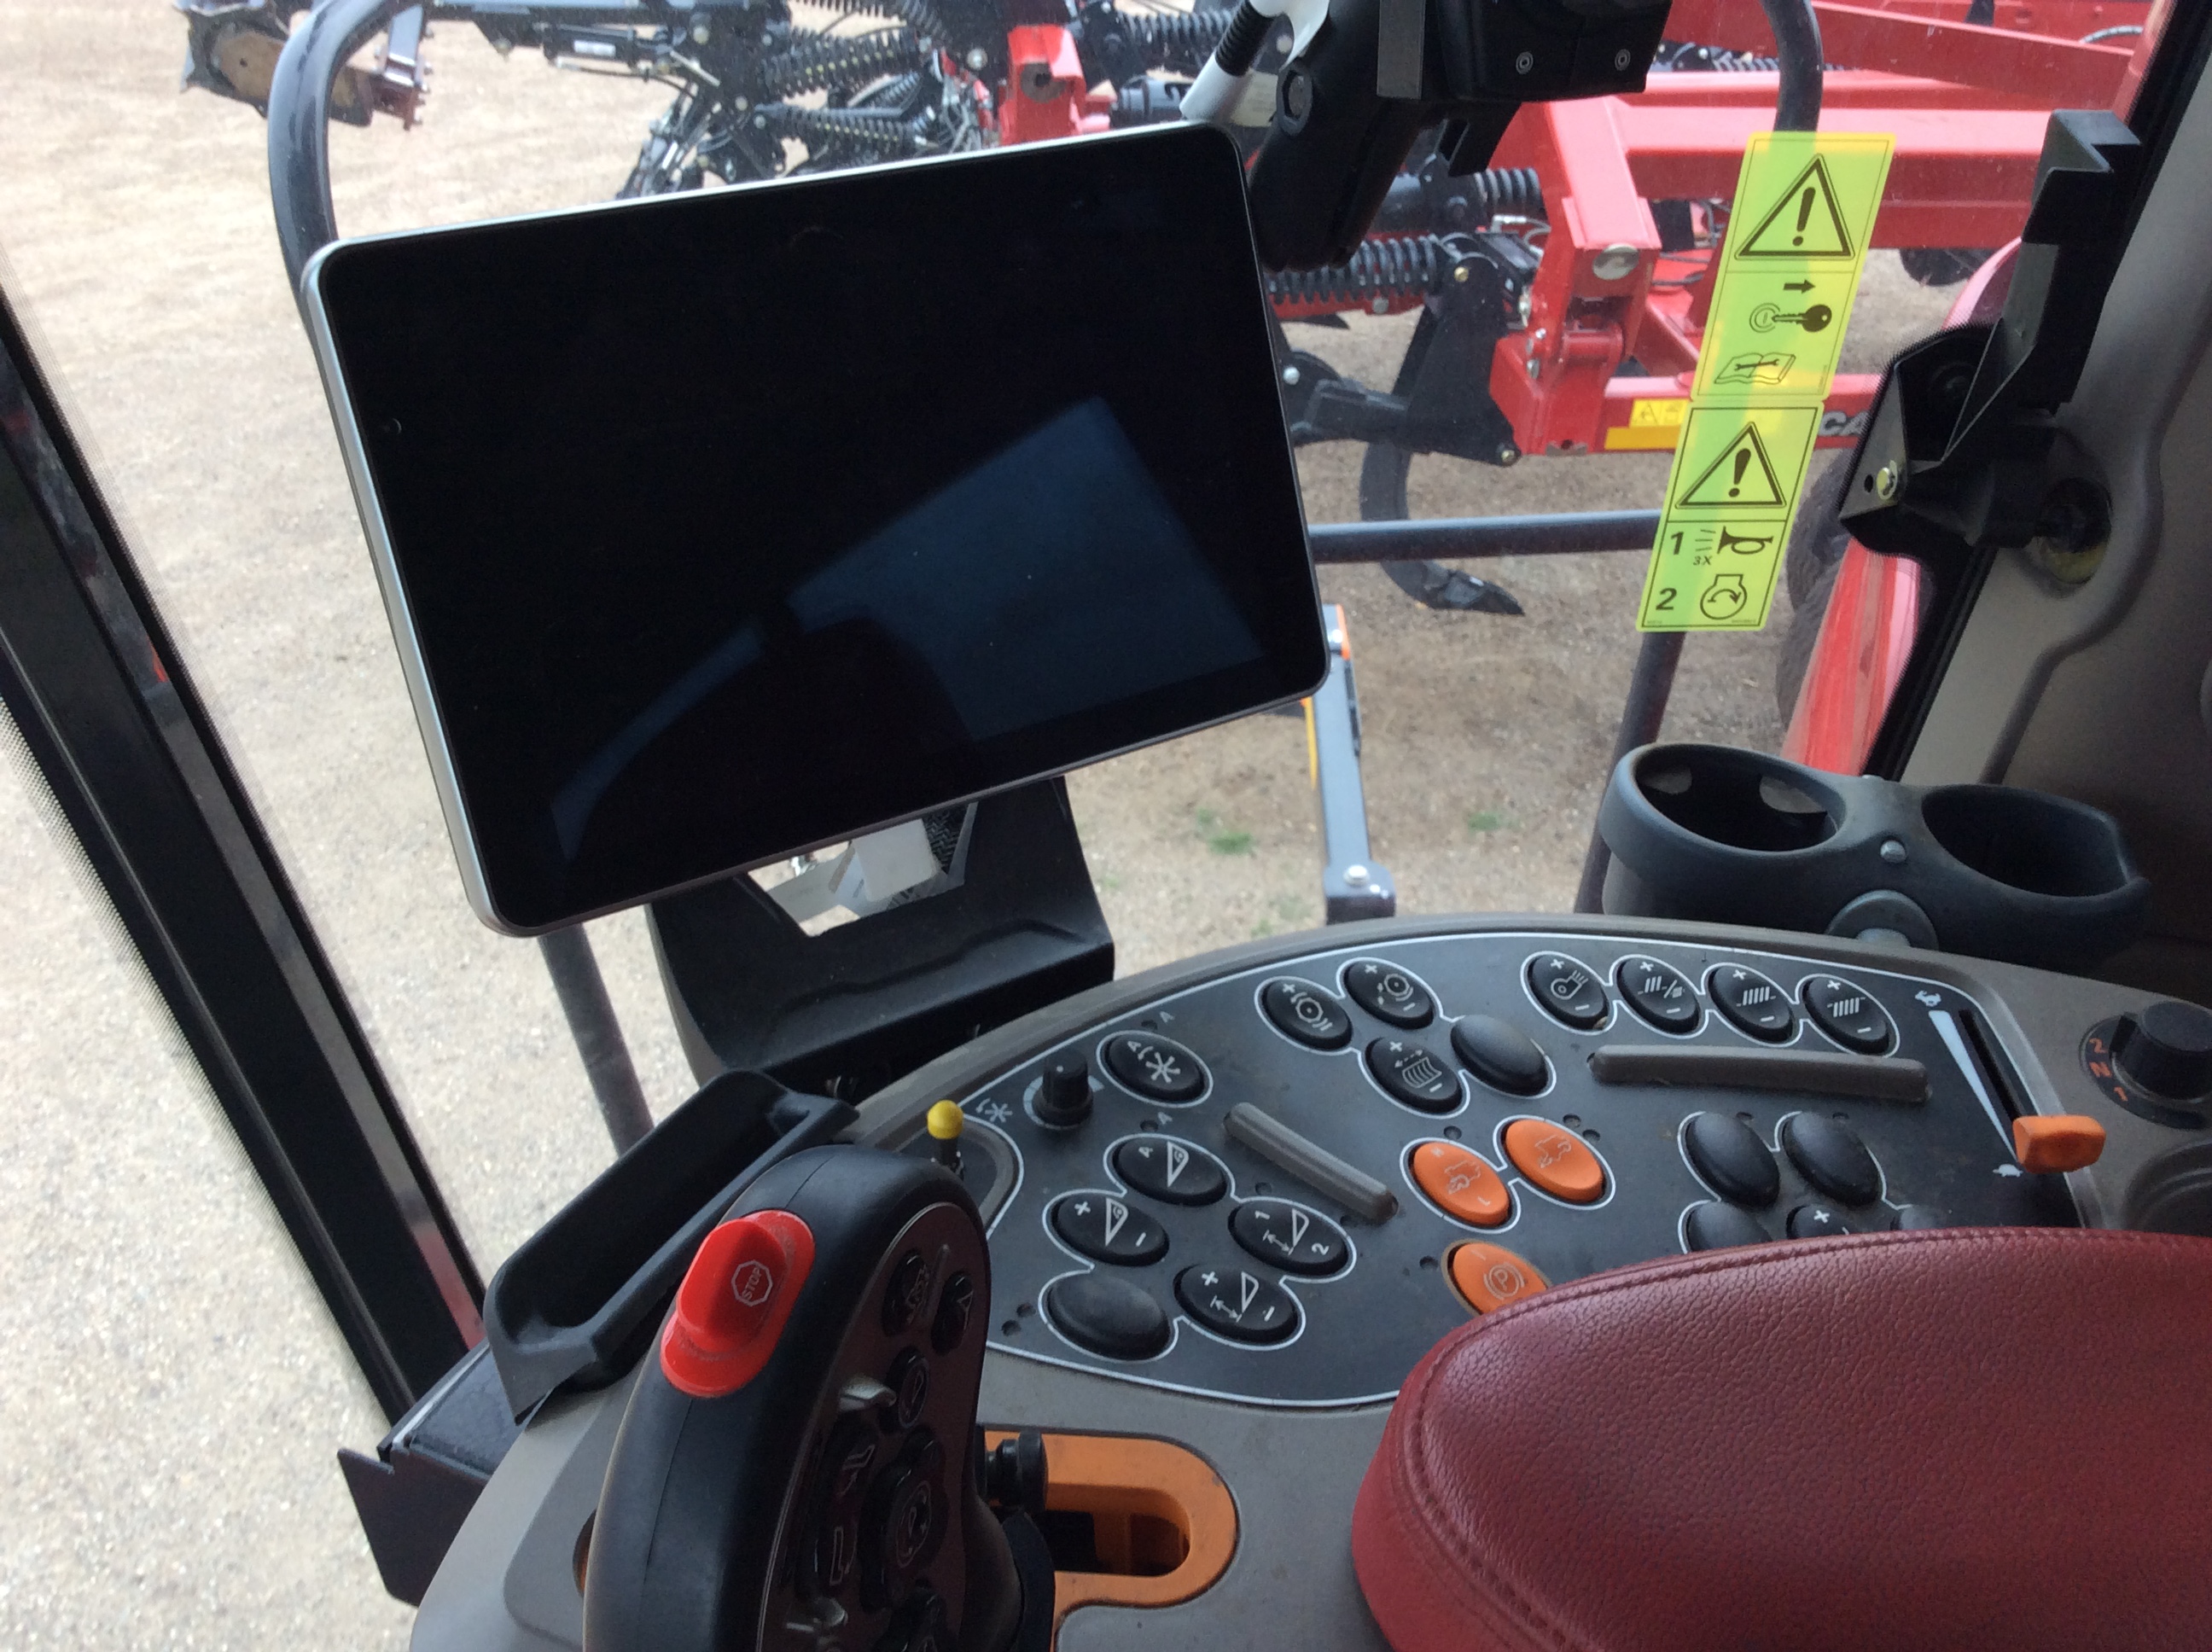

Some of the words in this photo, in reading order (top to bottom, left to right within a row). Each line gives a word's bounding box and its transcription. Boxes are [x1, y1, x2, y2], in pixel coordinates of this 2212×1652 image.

[1670, 531, 1685, 556] 1
[1692, 556, 1714, 566] 3X
[1656, 587, 1678, 611] 2
[1159, 1010, 1175, 1023] A
[1126, 1040, 1142, 1052] A
[2089, 1037, 2109, 1054] 2
[2088, 1062, 2113, 1079] N
[2113, 1086, 2128, 1102] 1
[1157, 1111, 1173, 1126] A
[1138, 1146, 1154, 1159] A
[1254, 1210, 1271, 1220] 1
[1311, 1242, 1330, 1256] 2
[741, 1267, 762, 1300] STOP
[1493, 1268, 1509, 1290] P
